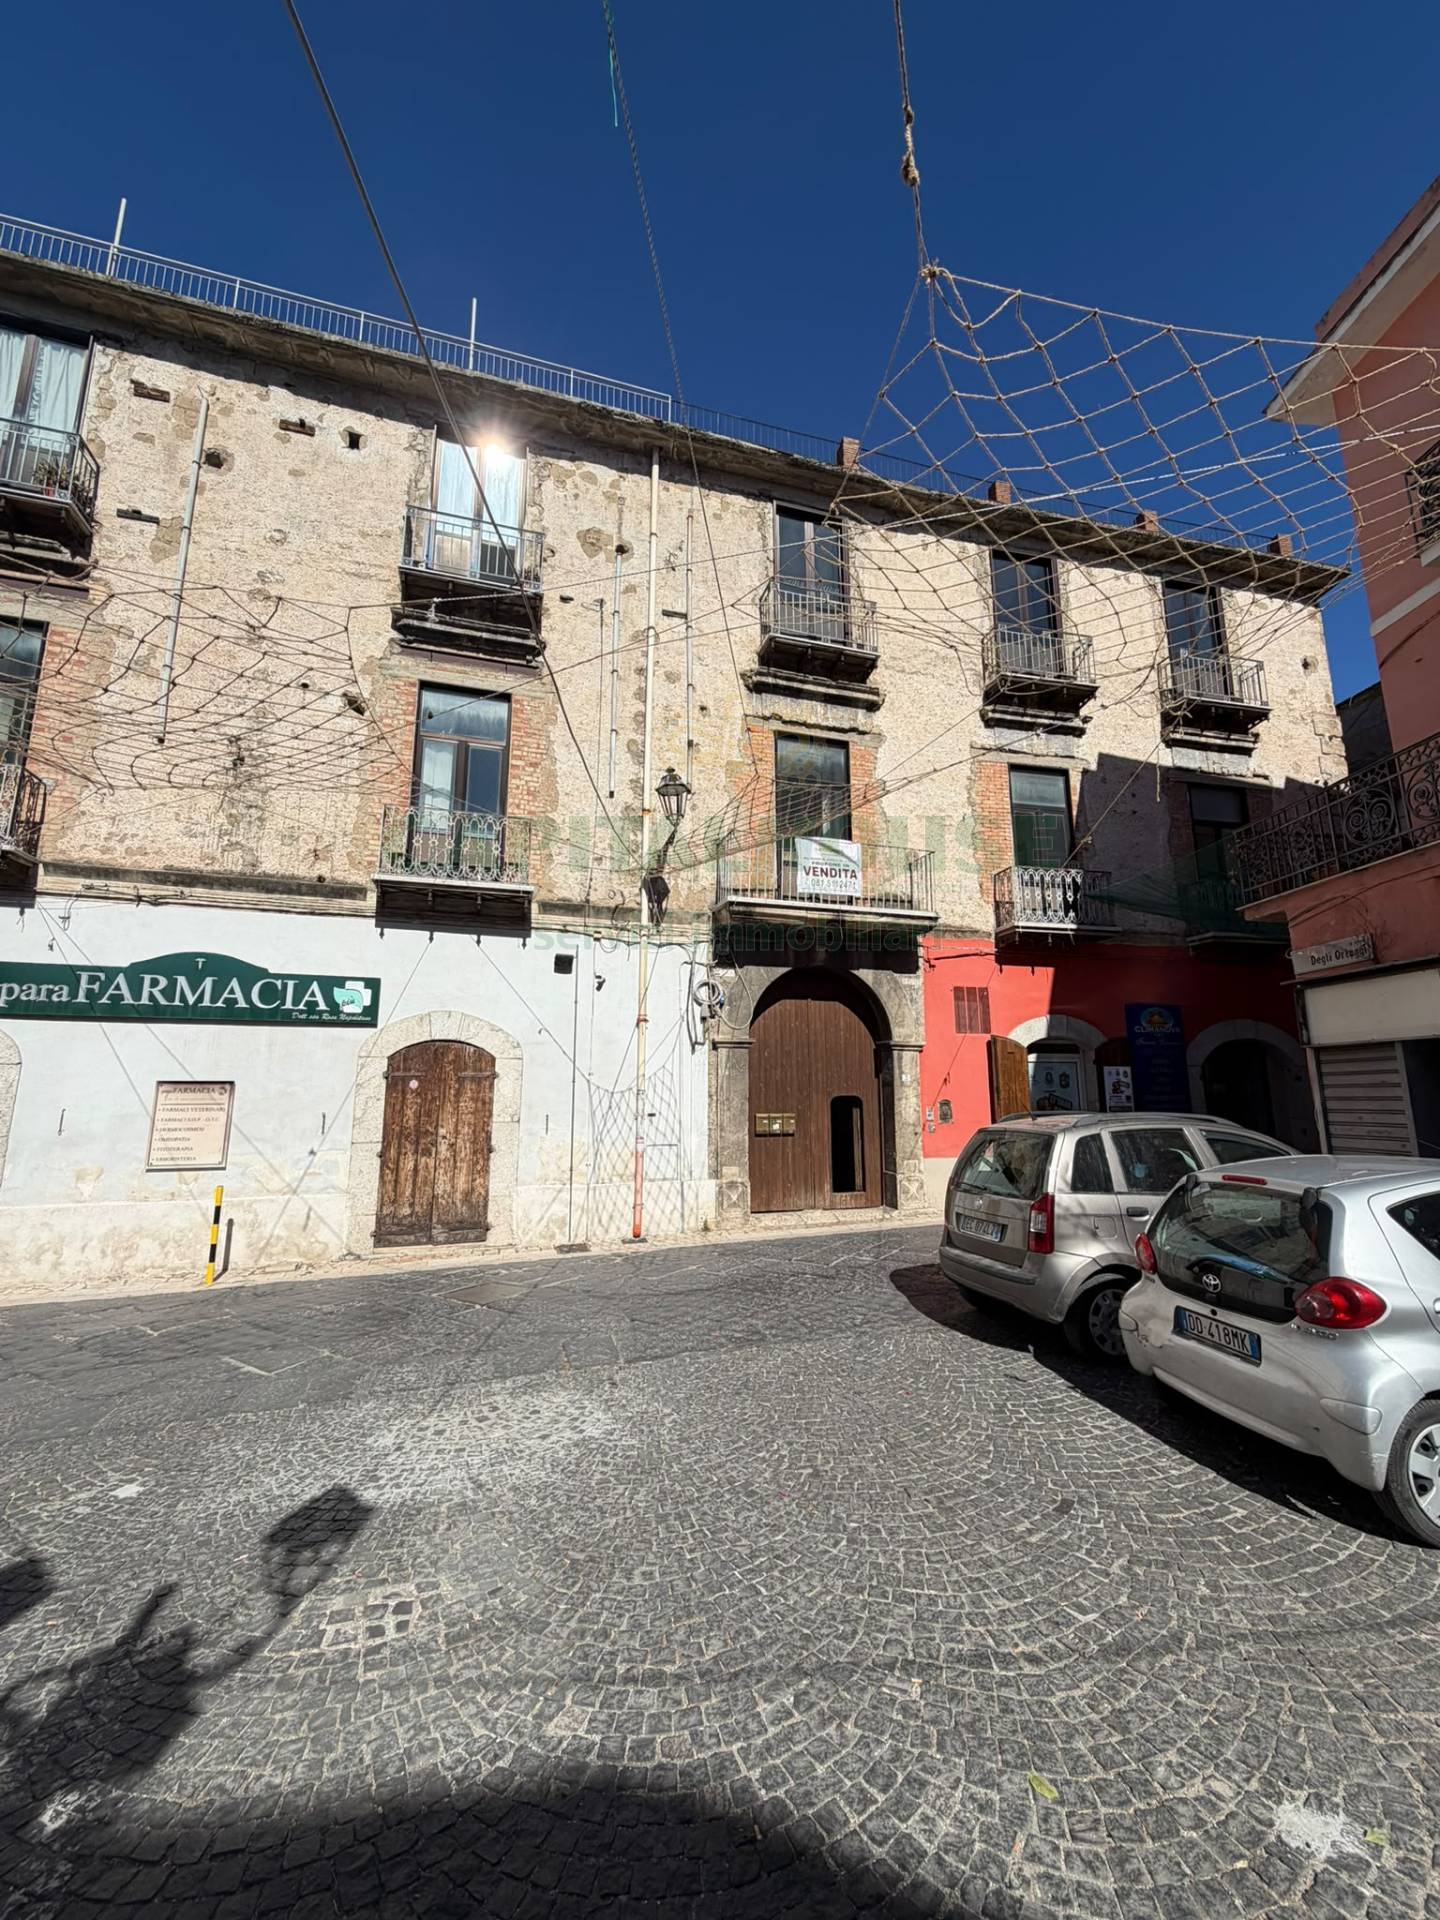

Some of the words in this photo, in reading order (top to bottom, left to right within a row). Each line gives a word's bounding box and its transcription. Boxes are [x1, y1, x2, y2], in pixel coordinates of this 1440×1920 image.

[803, 865, 857, 880] VENDITA
[1310, 952, 1333, 966] Degli
[1186, 1313, 1204, 1335] DD
[1206, 1319, 1250, 1354] 418MK
